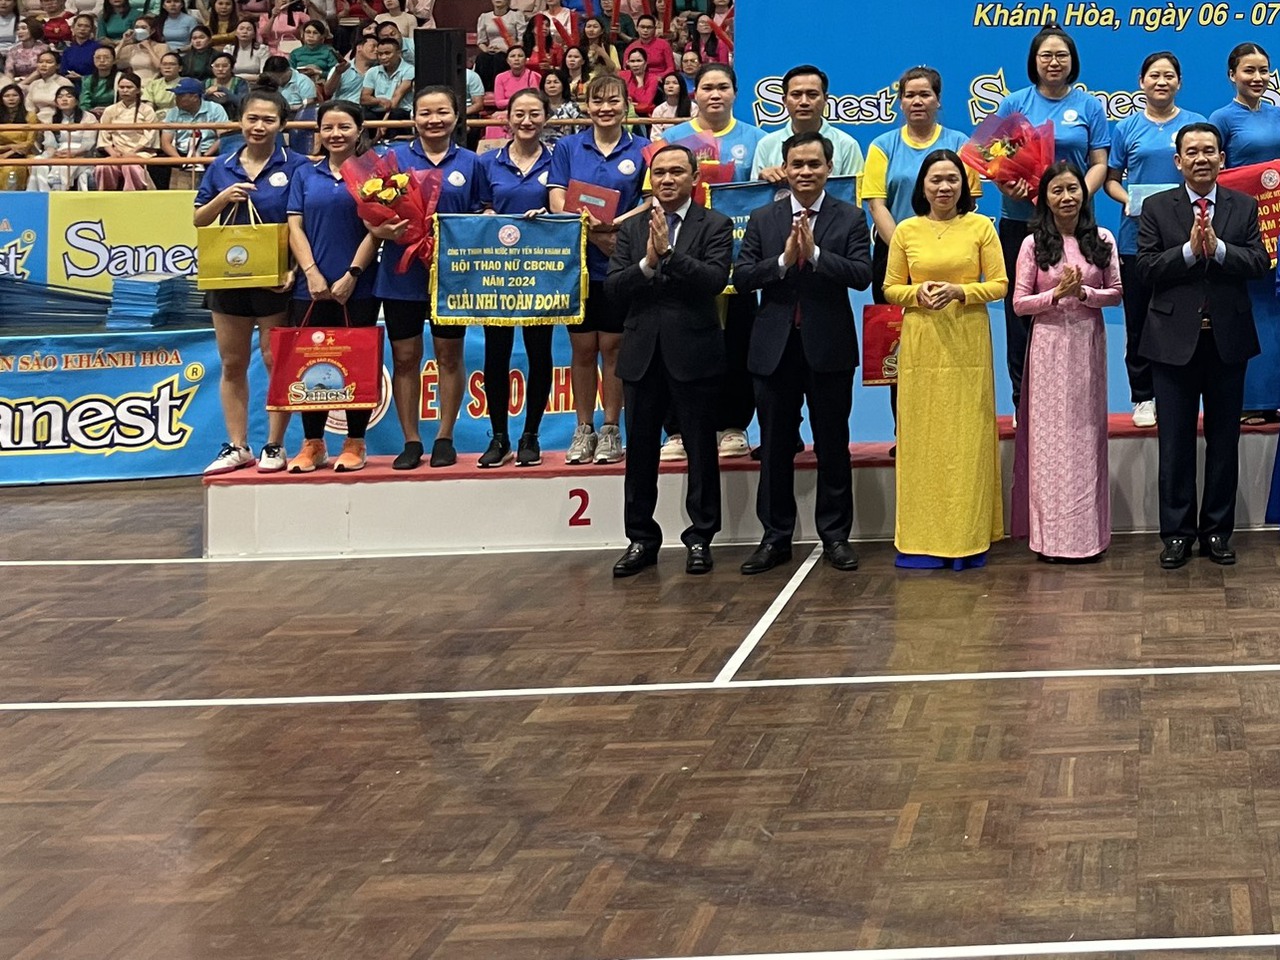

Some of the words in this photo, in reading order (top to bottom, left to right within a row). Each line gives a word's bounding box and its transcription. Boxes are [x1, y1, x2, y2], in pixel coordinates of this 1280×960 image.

[973, 3, 1058, 27] Khánh
[1063, 2, 1121, 30] Hòa,
[1129, 3, 1193, 32] ngày
[1197, 3, 1230, 26] 06
[62, 219, 199, 281] Sane
[451, 259, 470, 273] HỘI
[473, 261, 501, 271] THAO
[504, 258, 521, 271] NỮ
[523, 261, 564, 271] CBCNLĐ
[482, 275, 504, 286] NĂM
[508, 276, 536, 287] 2024
[447, 288, 473, 310] GIẢI
[476, 289, 498, 310] NHÌ
[500, 290, 533, 310] TOÀN
[534, 290, 570, 310] ĐOÀN
[62, 348, 135, 371] KHÁNH
[141, 348, 183, 367] HÒA
[288, 381, 356, 405] Sanest
[568, 488, 591, 527] 2
